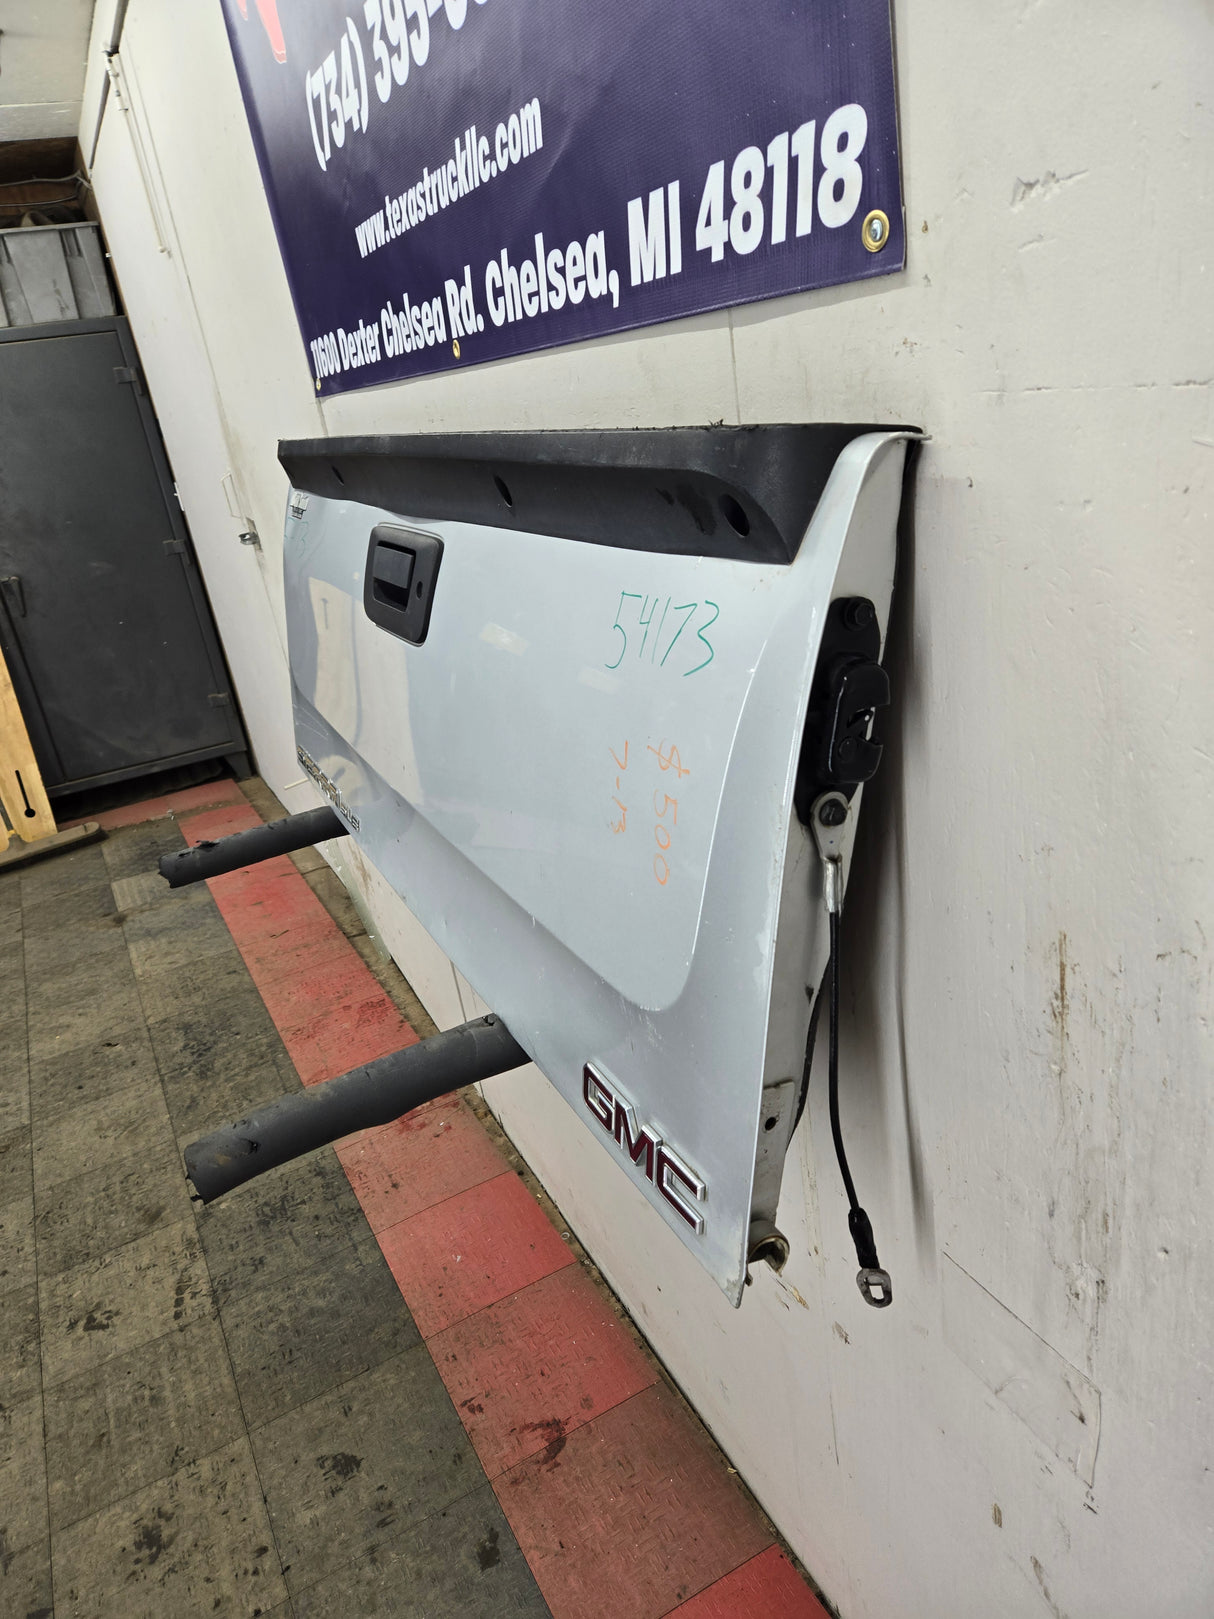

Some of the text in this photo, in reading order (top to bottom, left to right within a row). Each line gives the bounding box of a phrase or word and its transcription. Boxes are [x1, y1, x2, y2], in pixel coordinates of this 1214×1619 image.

[305, 17, 369, 172] (734)
[310, 103, 868, 379] 11600 Dexter Chelsea Rd. Chelsea, MI 48118
[355, 97, 543, 259] www.texastruckllc.com
[604, 590, 720, 677] 54173
[583, 1060, 707, 1236] GMC
